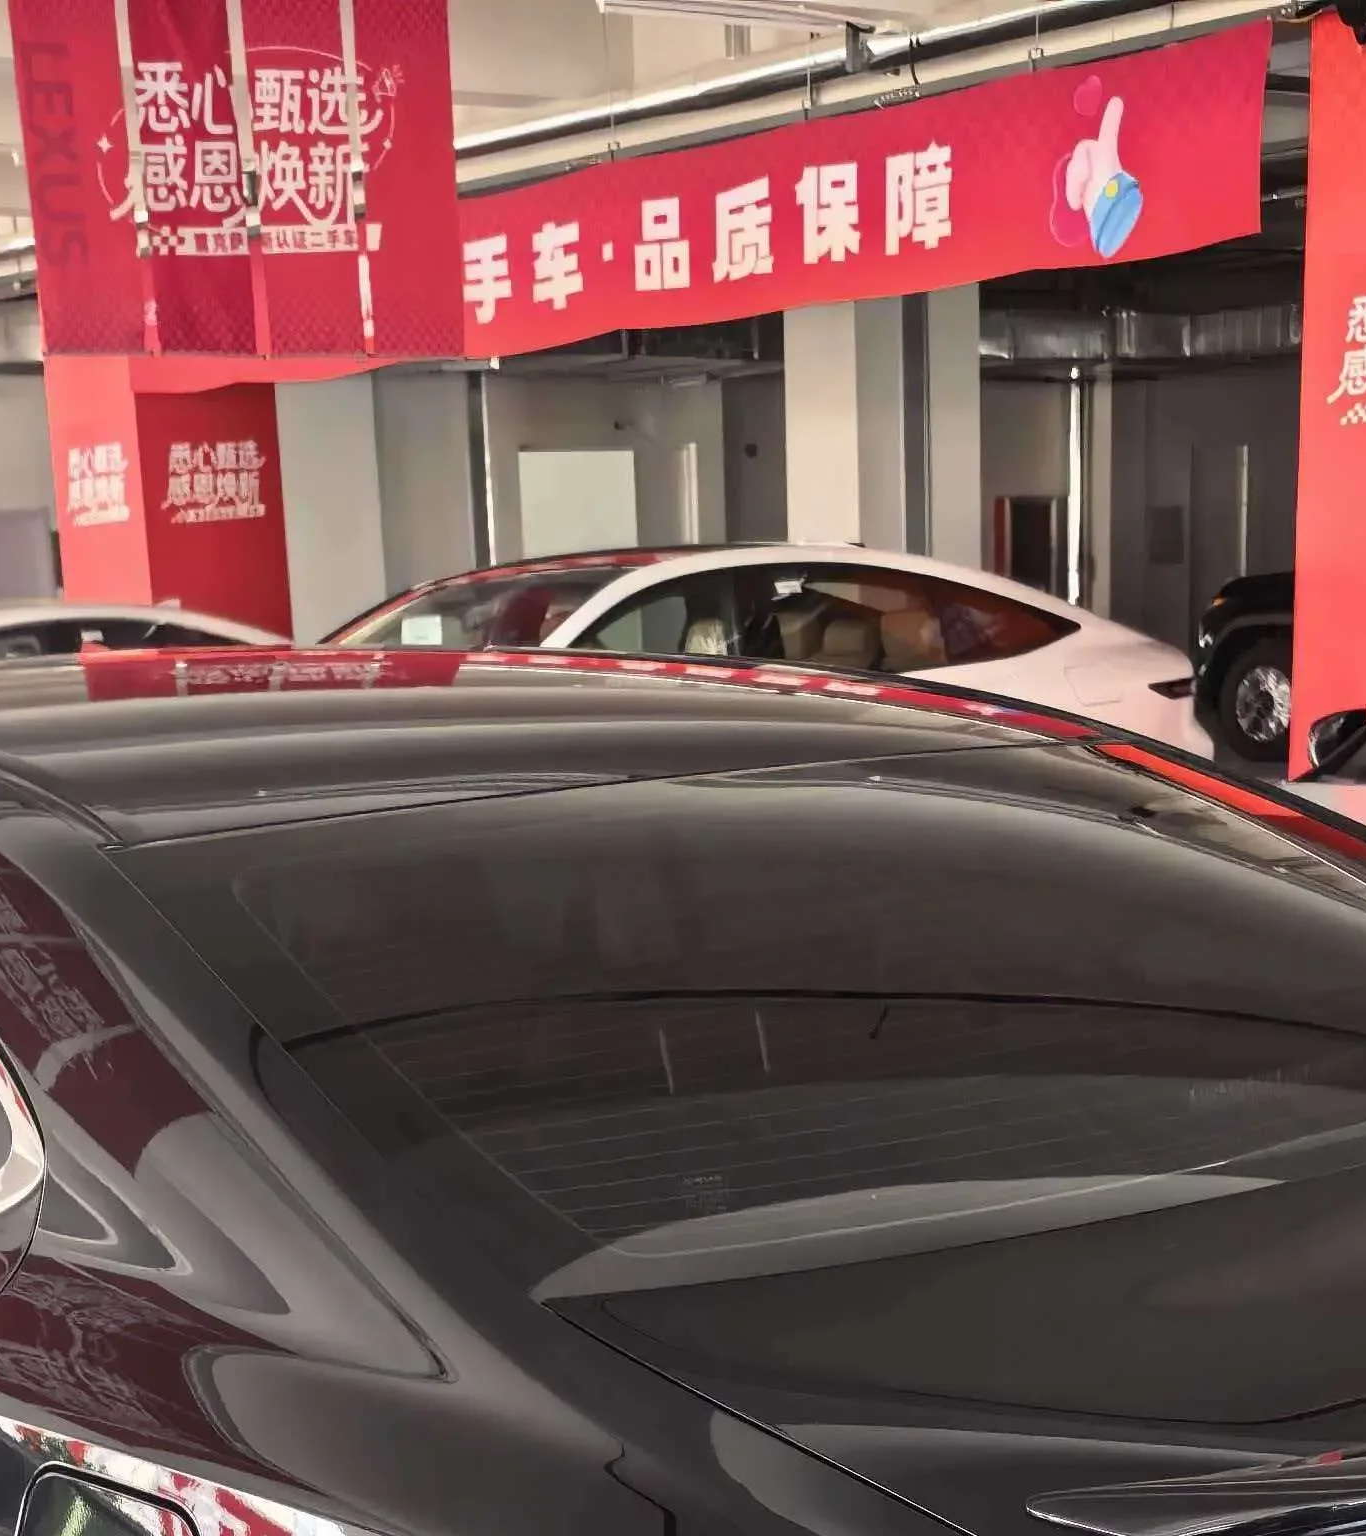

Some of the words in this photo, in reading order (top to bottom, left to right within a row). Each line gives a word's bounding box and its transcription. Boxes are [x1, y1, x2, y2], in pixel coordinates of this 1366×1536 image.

[135, 61, 384, 135] 悉心甄选
[20, 41, 89, 268] LEXUS
[110, 134, 370, 225] 感恩焕新
